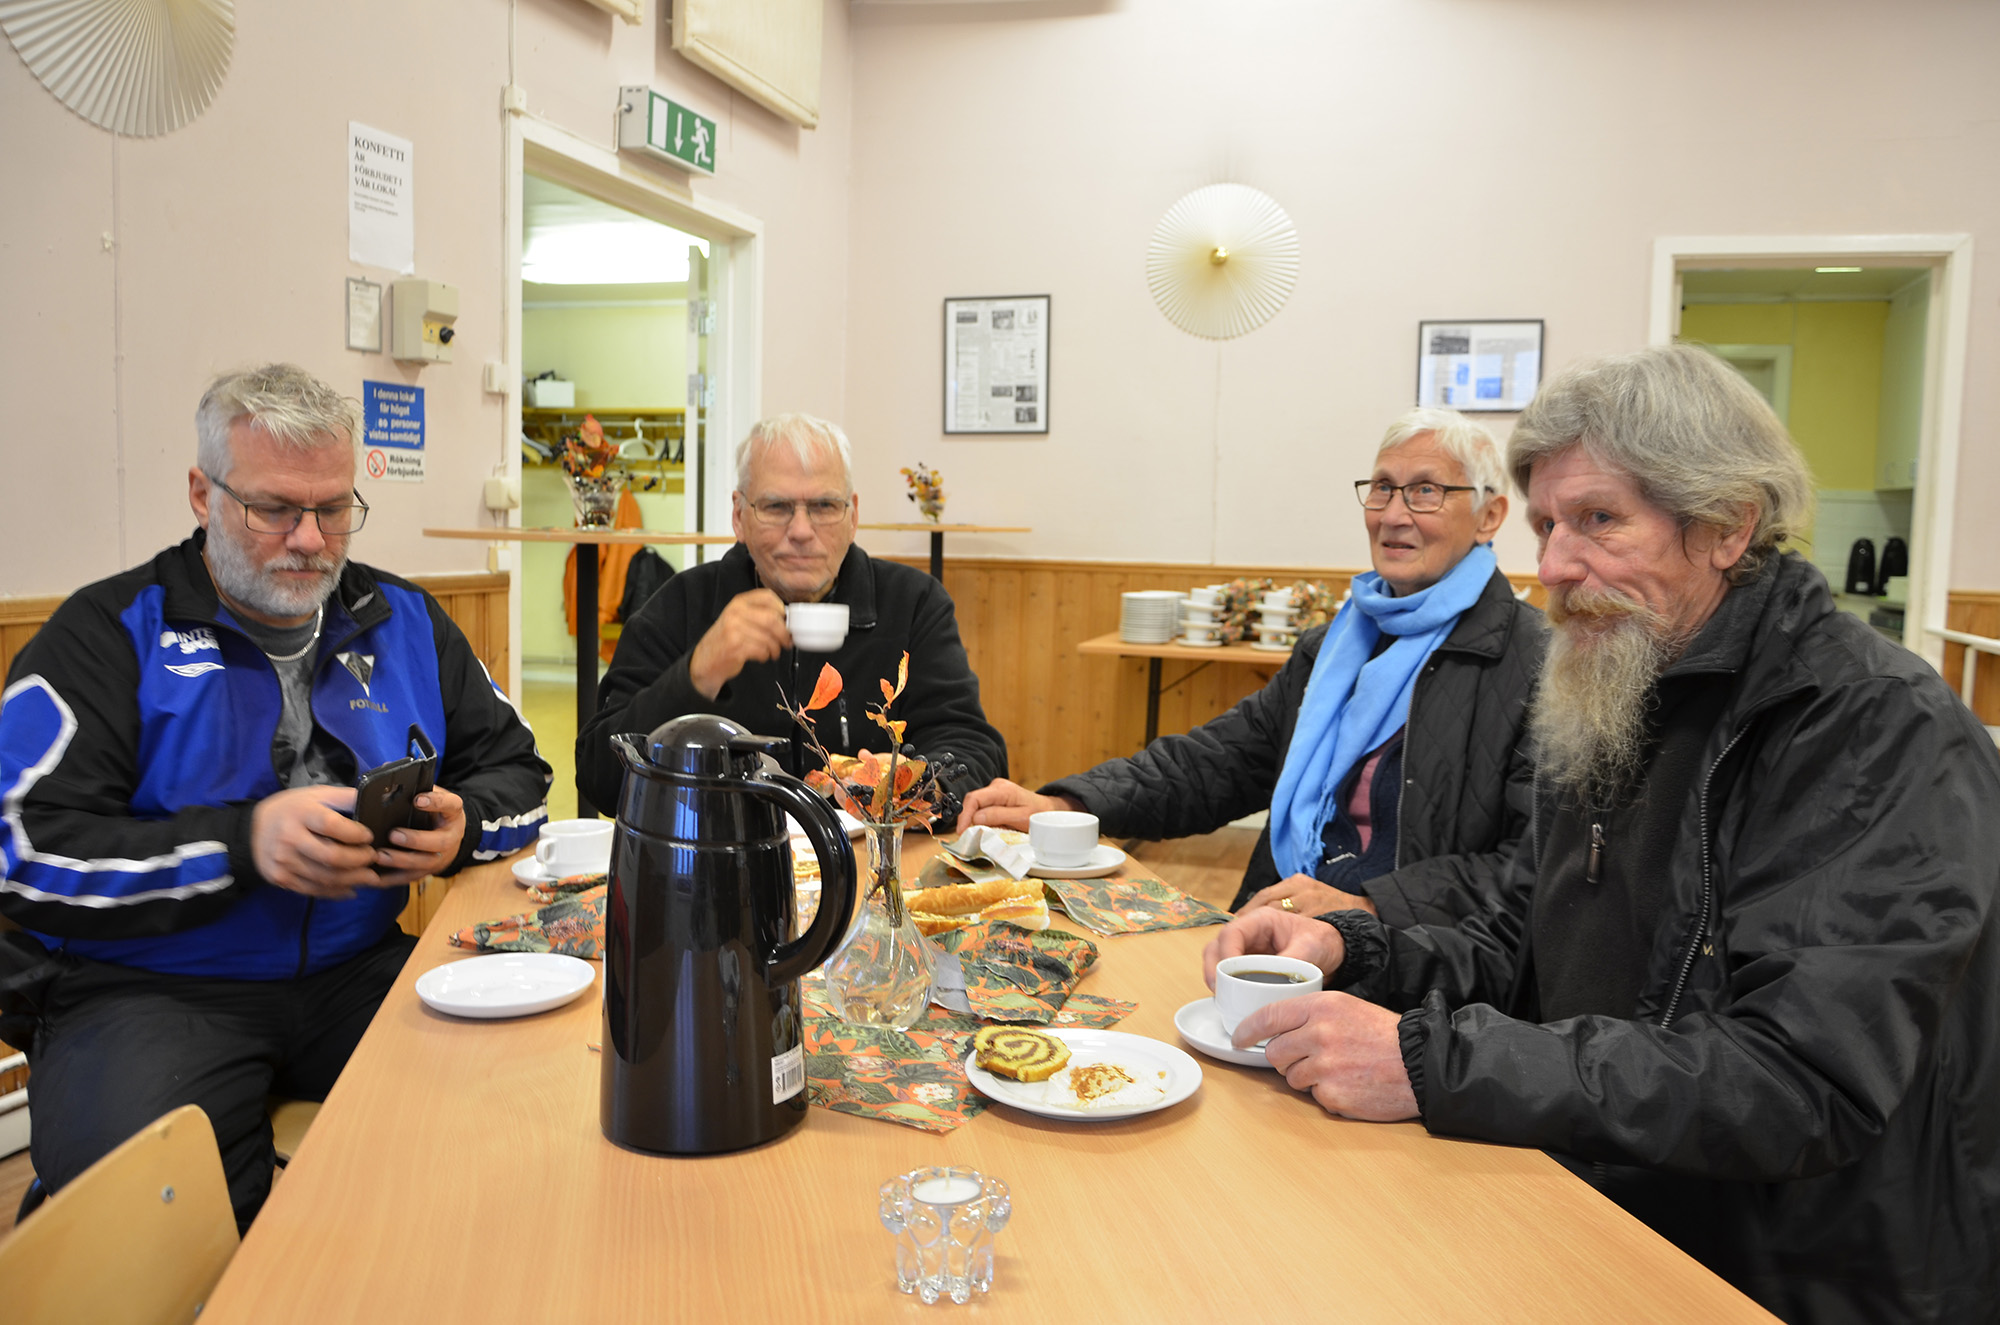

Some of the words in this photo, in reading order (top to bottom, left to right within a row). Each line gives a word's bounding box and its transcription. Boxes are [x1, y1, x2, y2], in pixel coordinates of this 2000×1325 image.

[354, 135, 405, 162] KONFETTI
[354, 163, 398, 185] FÖRBJUDET
[354, 176, 370, 187] VÅR
[371, 181, 398, 197] LOKAL
[378, 389, 399, 401] denna
[399, 391, 416, 403] lokal
[380, 402, 390, 414] får
[390, 403, 410, 417] högst
[391, 419, 420, 429] personer
[368, 428, 389, 441] vistas
[390, 431, 420, 445] samtidigt
[389, 454, 421, 468] Rökning
[386, 466, 424, 479] förbjuden
